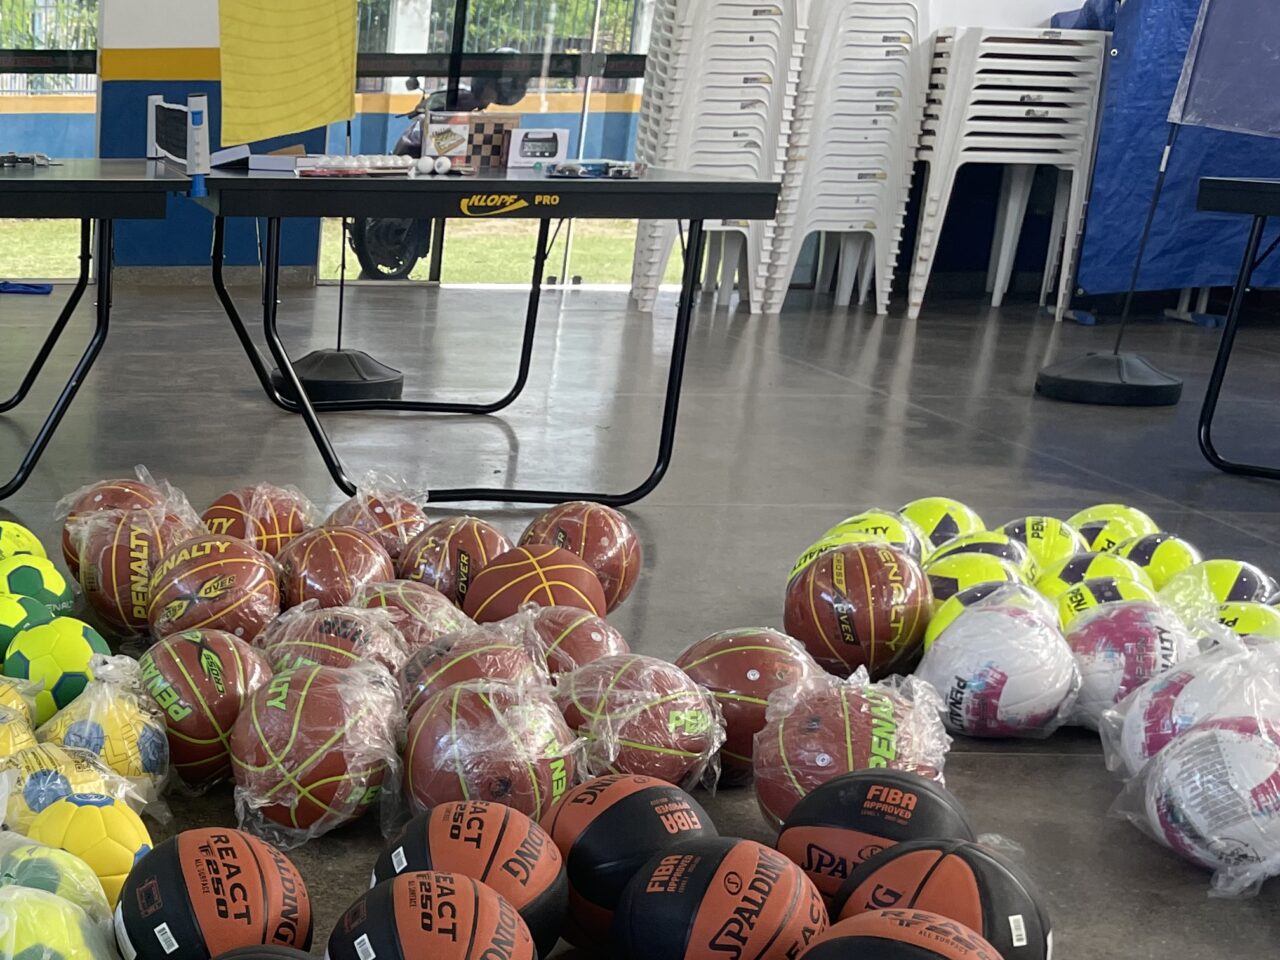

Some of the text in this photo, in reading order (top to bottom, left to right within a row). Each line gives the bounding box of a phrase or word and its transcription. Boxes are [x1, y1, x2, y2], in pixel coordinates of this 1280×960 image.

[468, 194, 560, 207] KLOPF PRO
[128, 524, 150, 619] PENALTY
[204, 575, 237, 598] OVER
[458, 552, 470, 594] OVER
[880, 548, 906, 652] ENALTY
[140, 655, 193, 722] PENAL
[202, 652, 227, 696] CROSS
[948, 674, 969, 732] PENALT
[863, 800, 913, 820] APPROVED
[866, 785, 919, 811] FIBA
[464, 802, 491, 850] ACT
[659, 809, 703, 834] FIBA
[205, 856, 230, 919] 250
[210, 834, 252, 926] REACT
[646, 854, 685, 894] FIBA
[666, 854, 696, 893] APPROVED
[419, 880, 434, 932] 250
[434, 872, 458, 943] EACT
